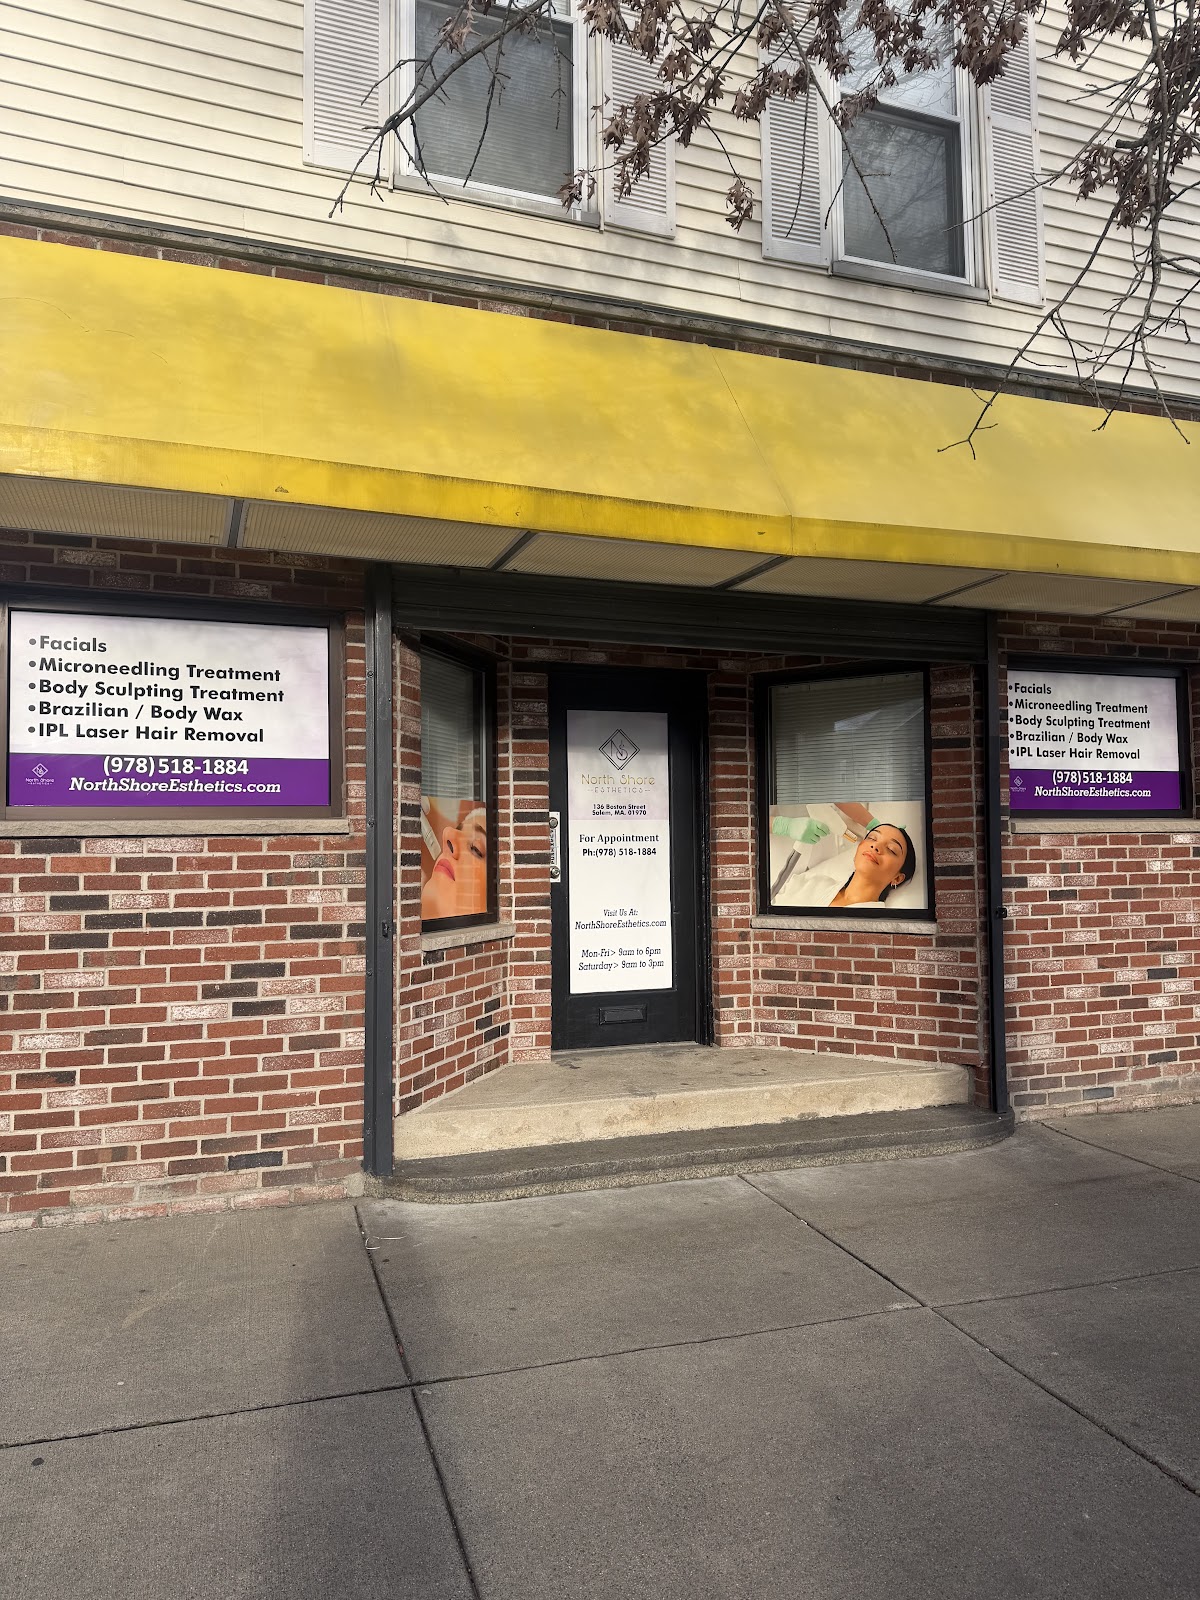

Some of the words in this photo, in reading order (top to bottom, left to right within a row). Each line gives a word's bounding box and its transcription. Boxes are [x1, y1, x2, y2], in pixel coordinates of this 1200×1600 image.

[39, 636, 107, 652] Facials
[39, 657, 180, 680] Microneedling
[186, 664, 281, 682] Treatment
[39, 679, 88, 697] Body
[95, 682, 183, 701] Sculpting
[190, 686, 284, 702] Treatment
[1014, 683, 1052, 694] Facials
[39, 702, 129, 717] Brazilian
[136, 705, 144, 719] /
[151, 706, 197, 723] Body
[204, 707, 243, 721] Wax
[1014, 699, 1092, 714] Microneedling
[1096, 702, 1148, 714] Treatment
[1016, 715, 1042, 728] Body
[1046, 716, 1094, 729] Sculpting
[1098, 718, 1150, 729] Treatment
[39, 723, 68, 737] IPL
[76, 724, 129, 739] Laser
[136, 726, 177, 740] Hair
[185, 728, 264, 742] Removal
[1016, 731, 1065, 742] Brazilian
[1069, 732, 1074, 743] /
[1077, 733, 1103, 745] Body
[1106, 734, 1128, 744] Wax
[1016, 747, 1033, 757] IPL
[1037, 747, 1066, 758] Laser
[1069, 748, 1093, 758] Hair
[1096, 748, 1140, 760] Removal
[69, 778, 280, 793] NorthShoreEsthetics.com
[582, 774, 614, 785] North
[620, 775, 655, 785] Shore
[1034, 786, 1151, 797] NorthShoreEsthetics.com
[580, 834, 595, 842] For
[597, 834, 659, 844] Appointment
[582, 849, 616, 857] Ph:(978)
[619, 848, 656, 856] 518-1884
[575, 920, 667, 930] NorthShoreEsthetics.com
[645, 947, 661, 956] 6pm
[648, 959, 664, 969] 3pm
